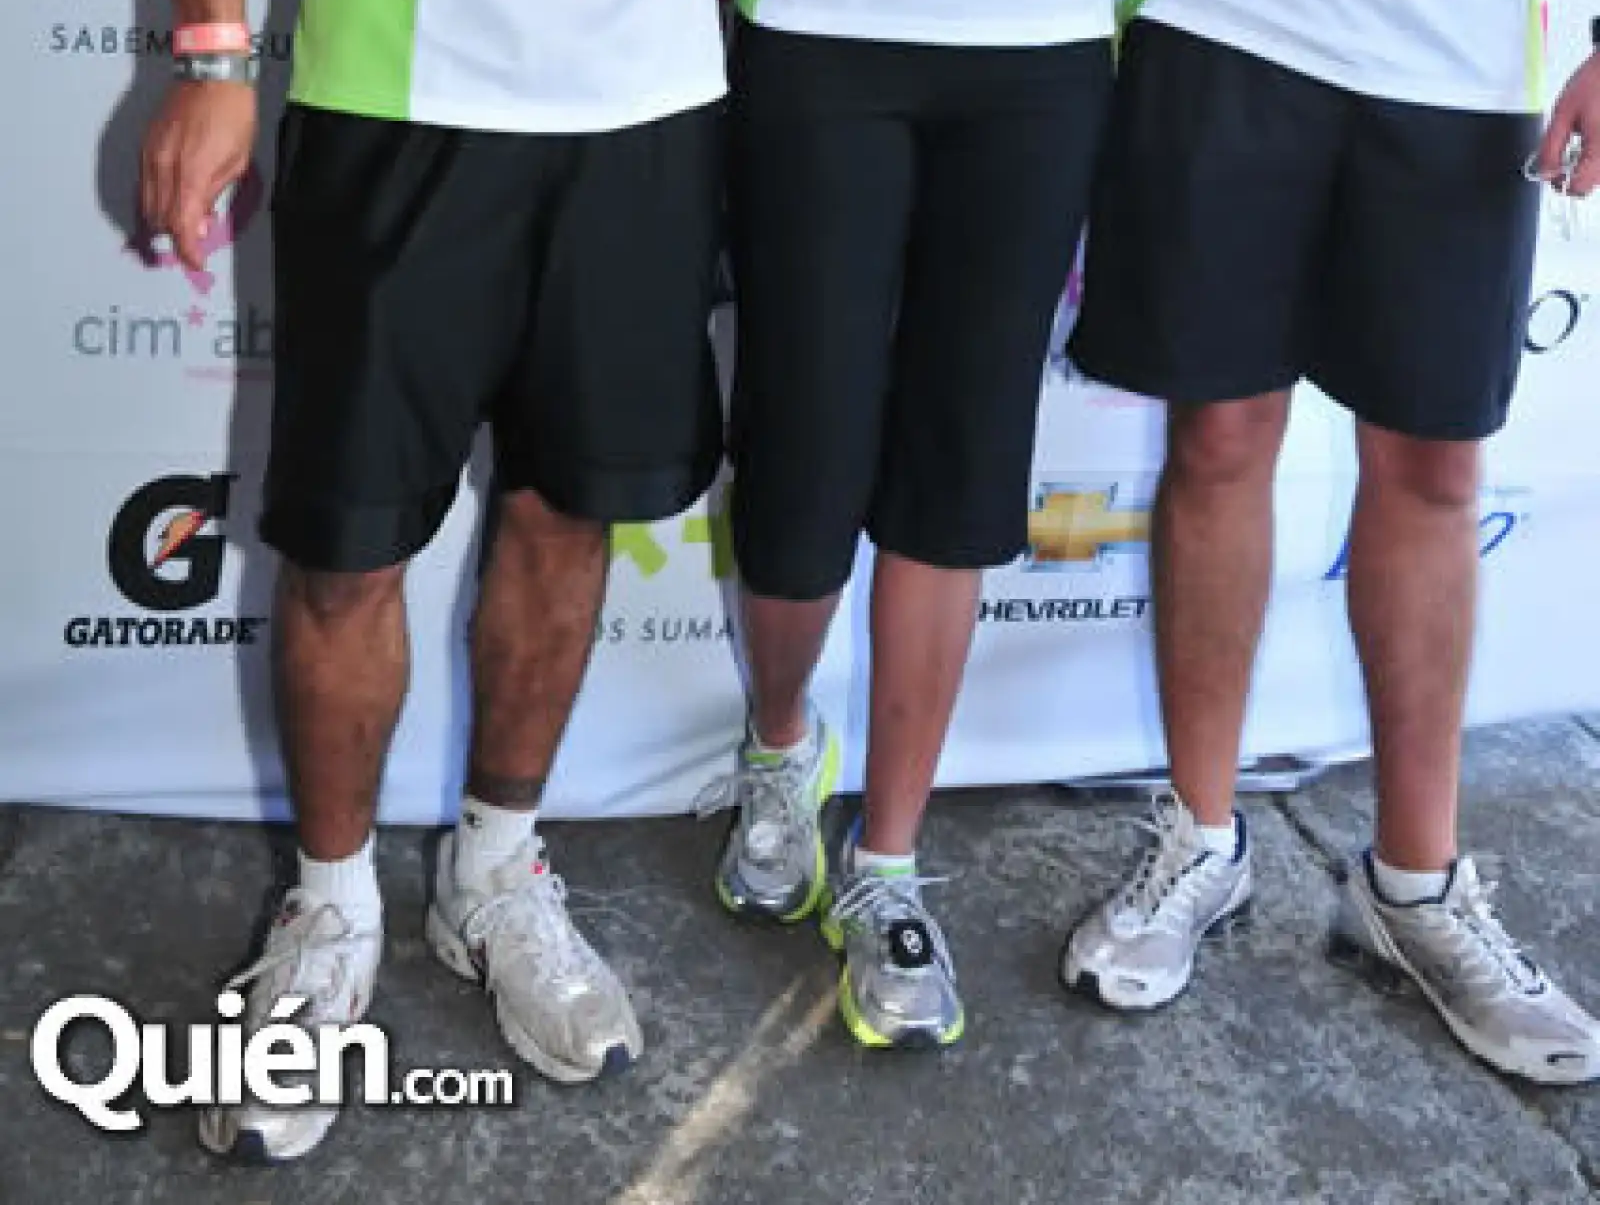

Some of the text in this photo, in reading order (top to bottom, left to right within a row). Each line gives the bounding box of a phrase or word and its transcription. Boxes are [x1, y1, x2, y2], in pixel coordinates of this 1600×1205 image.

[50, 23, 173, 55] SABEM
[978, 594, 1152, 627] HEVROLET
[64, 615, 269, 647] GATORADE
[637, 616, 736, 644] SUMA
